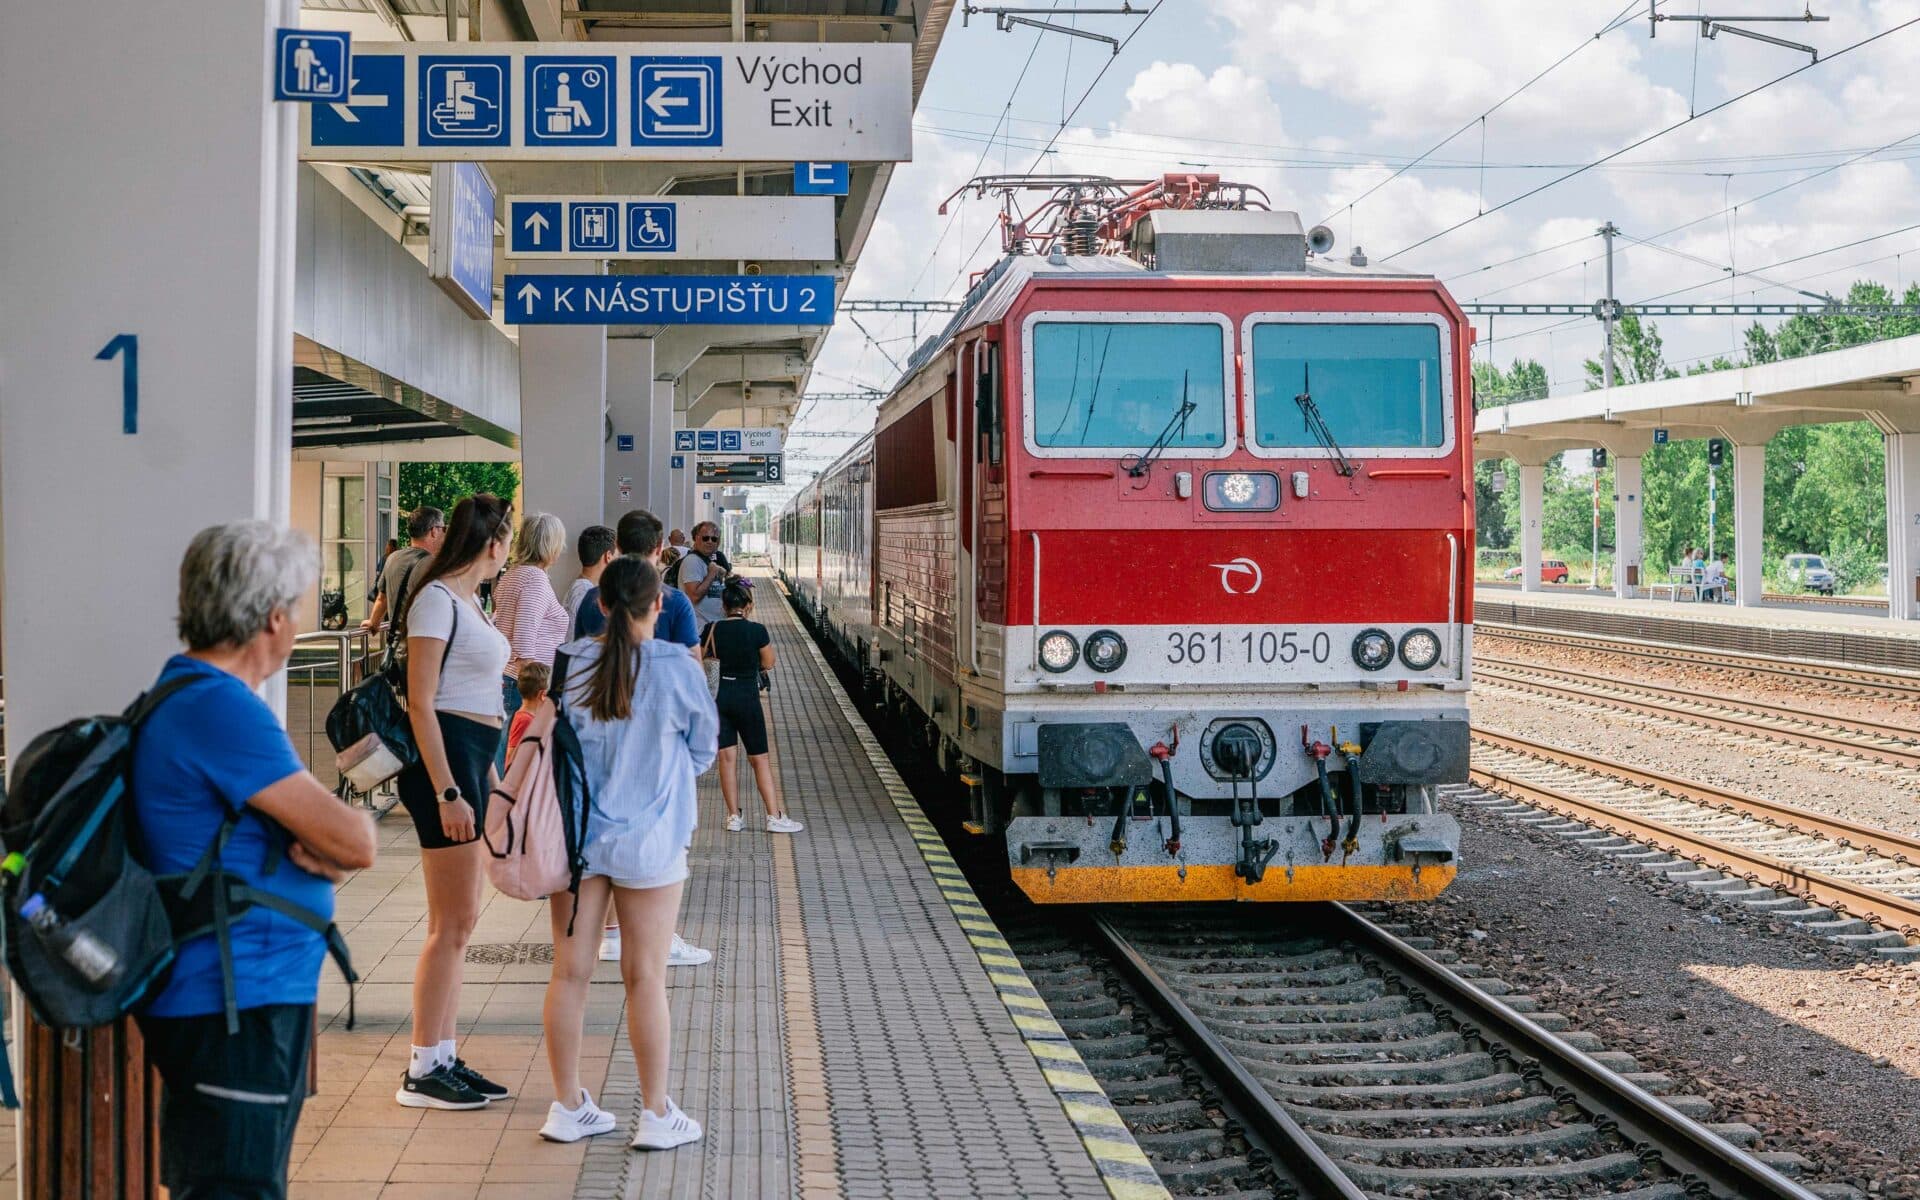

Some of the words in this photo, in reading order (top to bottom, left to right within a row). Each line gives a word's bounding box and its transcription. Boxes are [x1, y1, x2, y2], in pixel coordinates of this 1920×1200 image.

[736, 56, 861, 92] Východ
[771, 99, 832, 127] Exit
[809, 162, 834, 184] E
[554, 287, 575, 312] K
[585, 281, 788, 313] NÁSTUPIŠŤU
[800, 288, 816, 312] 2
[94, 333, 138, 435] 1
[1658, 432, 1665, 441] F
[770, 466, 778, 478] 3
[1167, 632, 1222, 664] 361
[1241, 631, 1331, 664] 105-0
